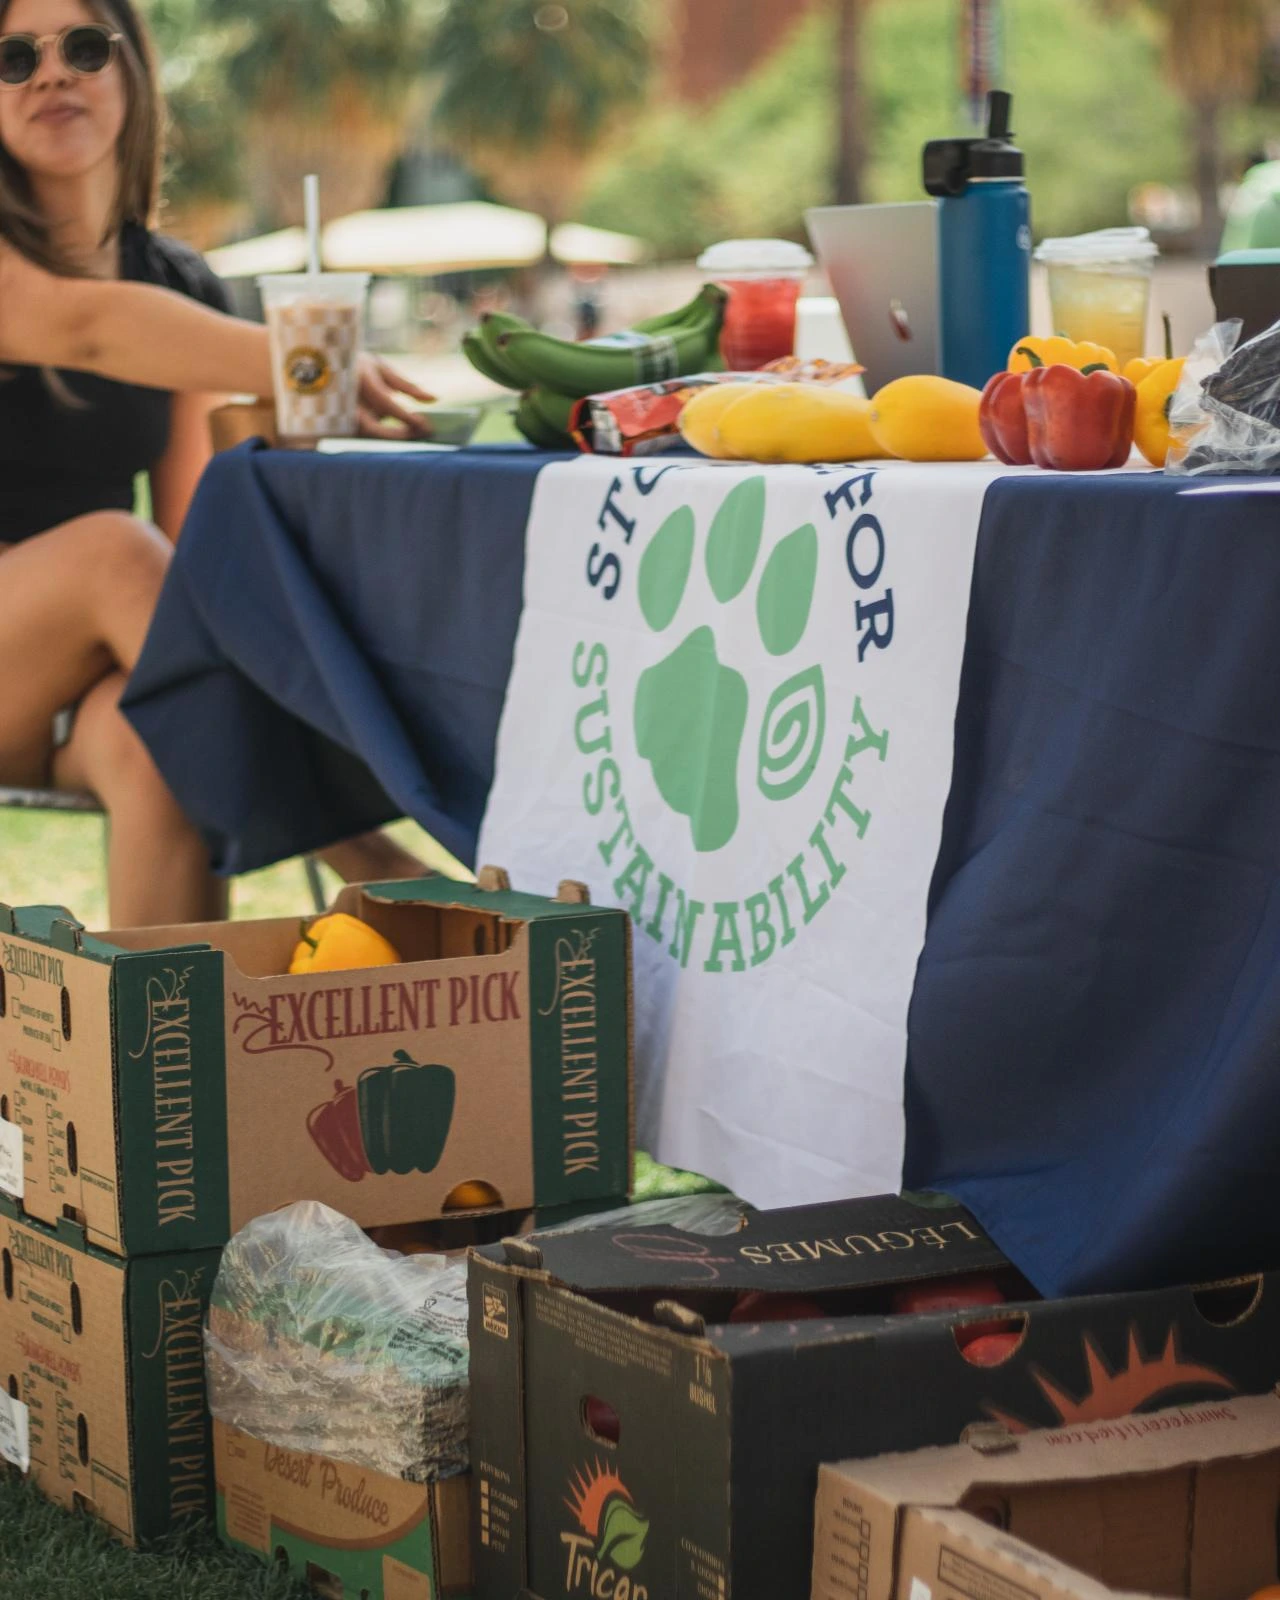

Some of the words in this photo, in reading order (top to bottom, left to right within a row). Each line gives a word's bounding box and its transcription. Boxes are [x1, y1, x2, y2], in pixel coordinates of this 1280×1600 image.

[823, 471, 895, 664] FOR
[572, 640, 890, 974] SUSTAINABILITY
[256, 978, 440, 1049] EXCELLENT
[448, 970, 521, 1026] PICK
[554, 949, 599, 1103] EXCELLENT
[145, 990, 194, 1149] EXCELLENT
[562, 1112, 600, 1177] PICK
[155, 1156, 197, 1228] PICK
[738, 1220, 982, 1265] LÉGUMES
[159, 1292, 206, 1446] EXCELLENT
[167, 1455, 207, 1520] PICK
[319, 1461, 390, 1527] Produce
